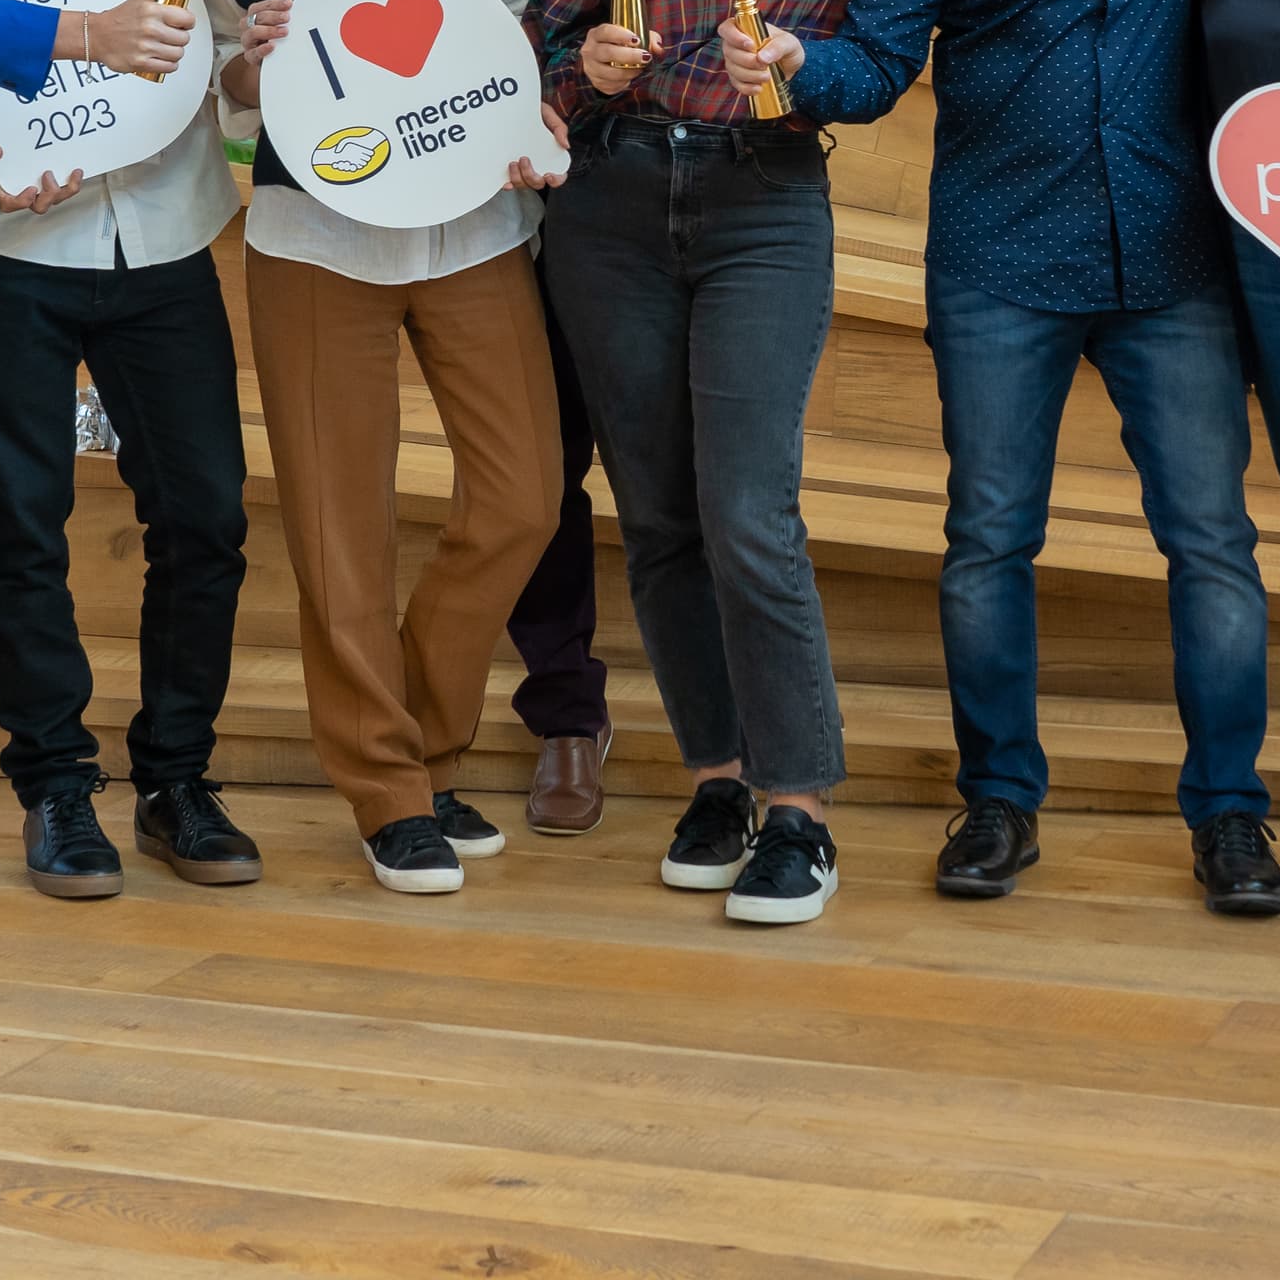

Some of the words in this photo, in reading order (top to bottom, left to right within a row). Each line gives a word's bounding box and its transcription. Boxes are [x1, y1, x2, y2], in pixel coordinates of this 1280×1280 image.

[16, 61, 67, 104] el
[308, 28, 346, 100] I
[28, 98, 116, 150] 2023
[395, 77, 519, 135] mercado
[402, 124, 466, 159] libre
